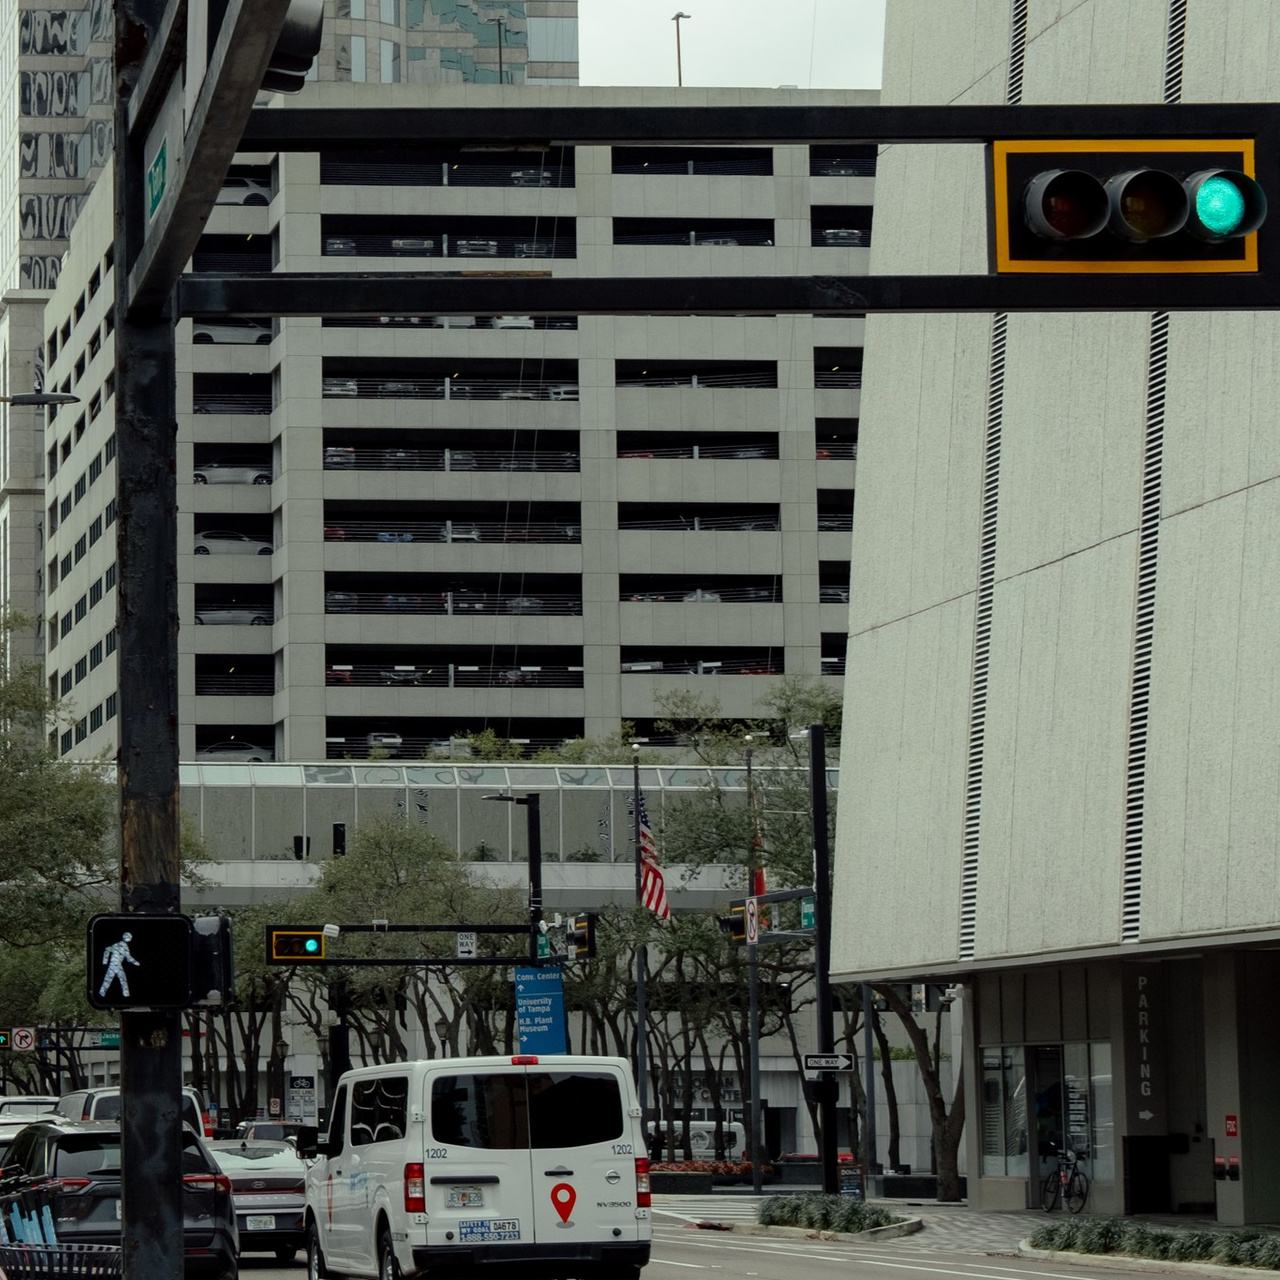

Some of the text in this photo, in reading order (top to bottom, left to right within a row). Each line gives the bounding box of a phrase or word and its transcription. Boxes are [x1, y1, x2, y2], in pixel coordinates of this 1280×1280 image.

[537, 972, 560, 980] Center
[518, 997, 552, 1006] University
[527, 1005, 551, 1014] Tampa
[519, 1025, 549, 1033] Museum
[1138, 976, 1151, 1097] PARKING
[425, 1148, 448, 1159] 1202
[611, 1144, 633, 1155] 1202
